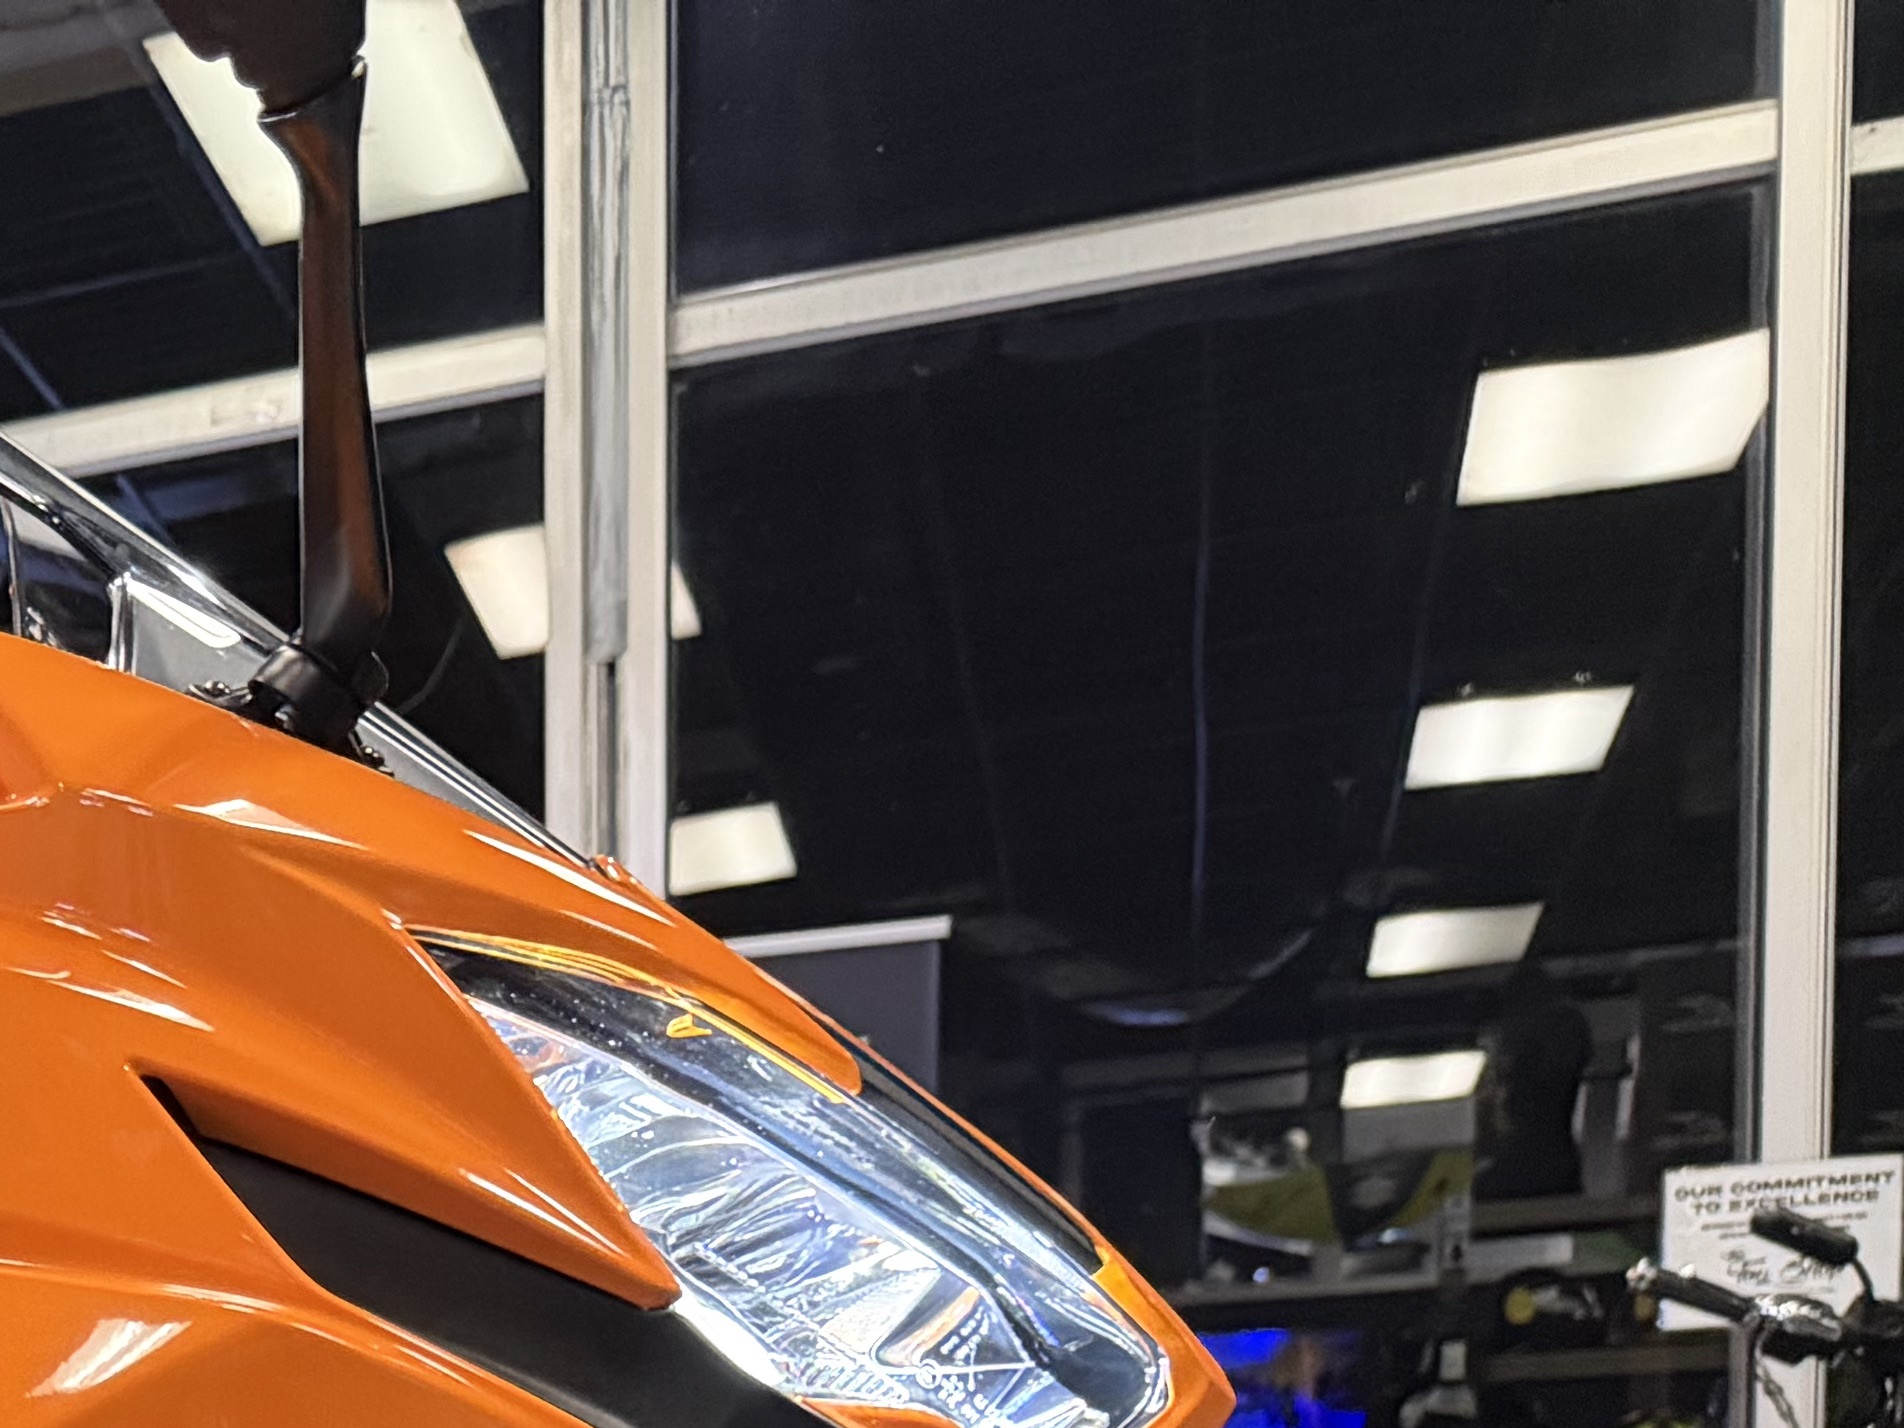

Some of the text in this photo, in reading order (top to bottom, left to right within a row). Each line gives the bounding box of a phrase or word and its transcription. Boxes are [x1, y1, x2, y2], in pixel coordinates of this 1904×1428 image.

[1674, 1170, 1896, 1202] OUR COMMITMENT
[1692, 1202, 1721, 1217] TO
